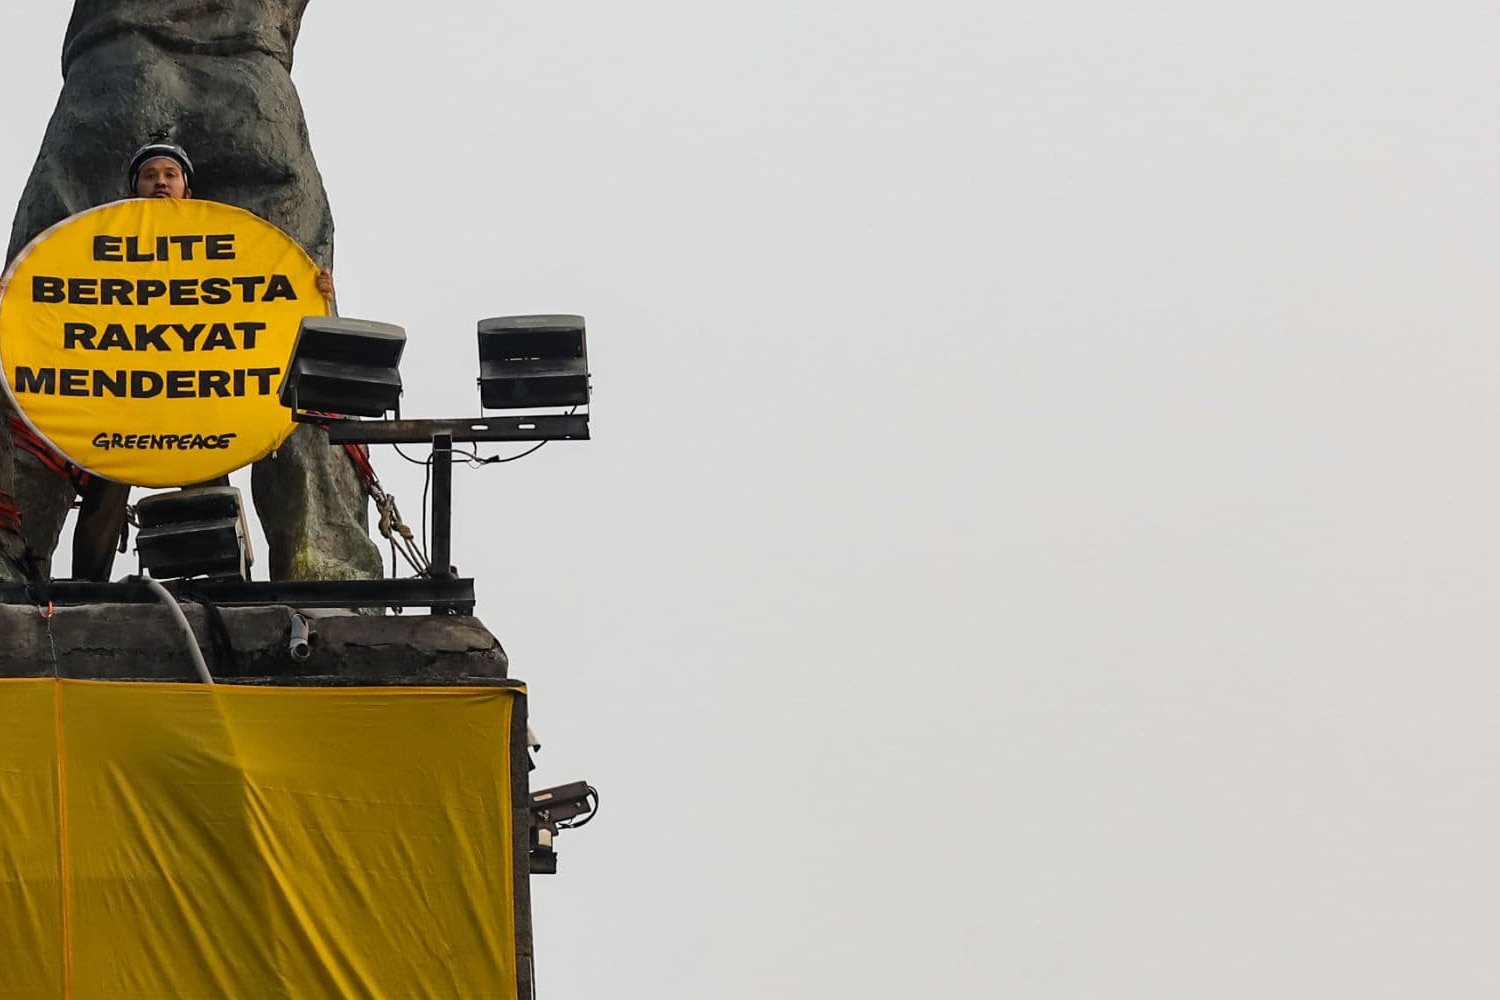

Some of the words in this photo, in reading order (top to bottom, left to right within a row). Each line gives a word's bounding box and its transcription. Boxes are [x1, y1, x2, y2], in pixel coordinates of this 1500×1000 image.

[92, 234, 236, 262] ELITE
[32, 274, 298, 305] BERPESTA
[63, 322, 266, 352] RAKYAT
[14, 366, 284, 399] MENDERIT
[91, 432, 238, 451] GREENPEACE
